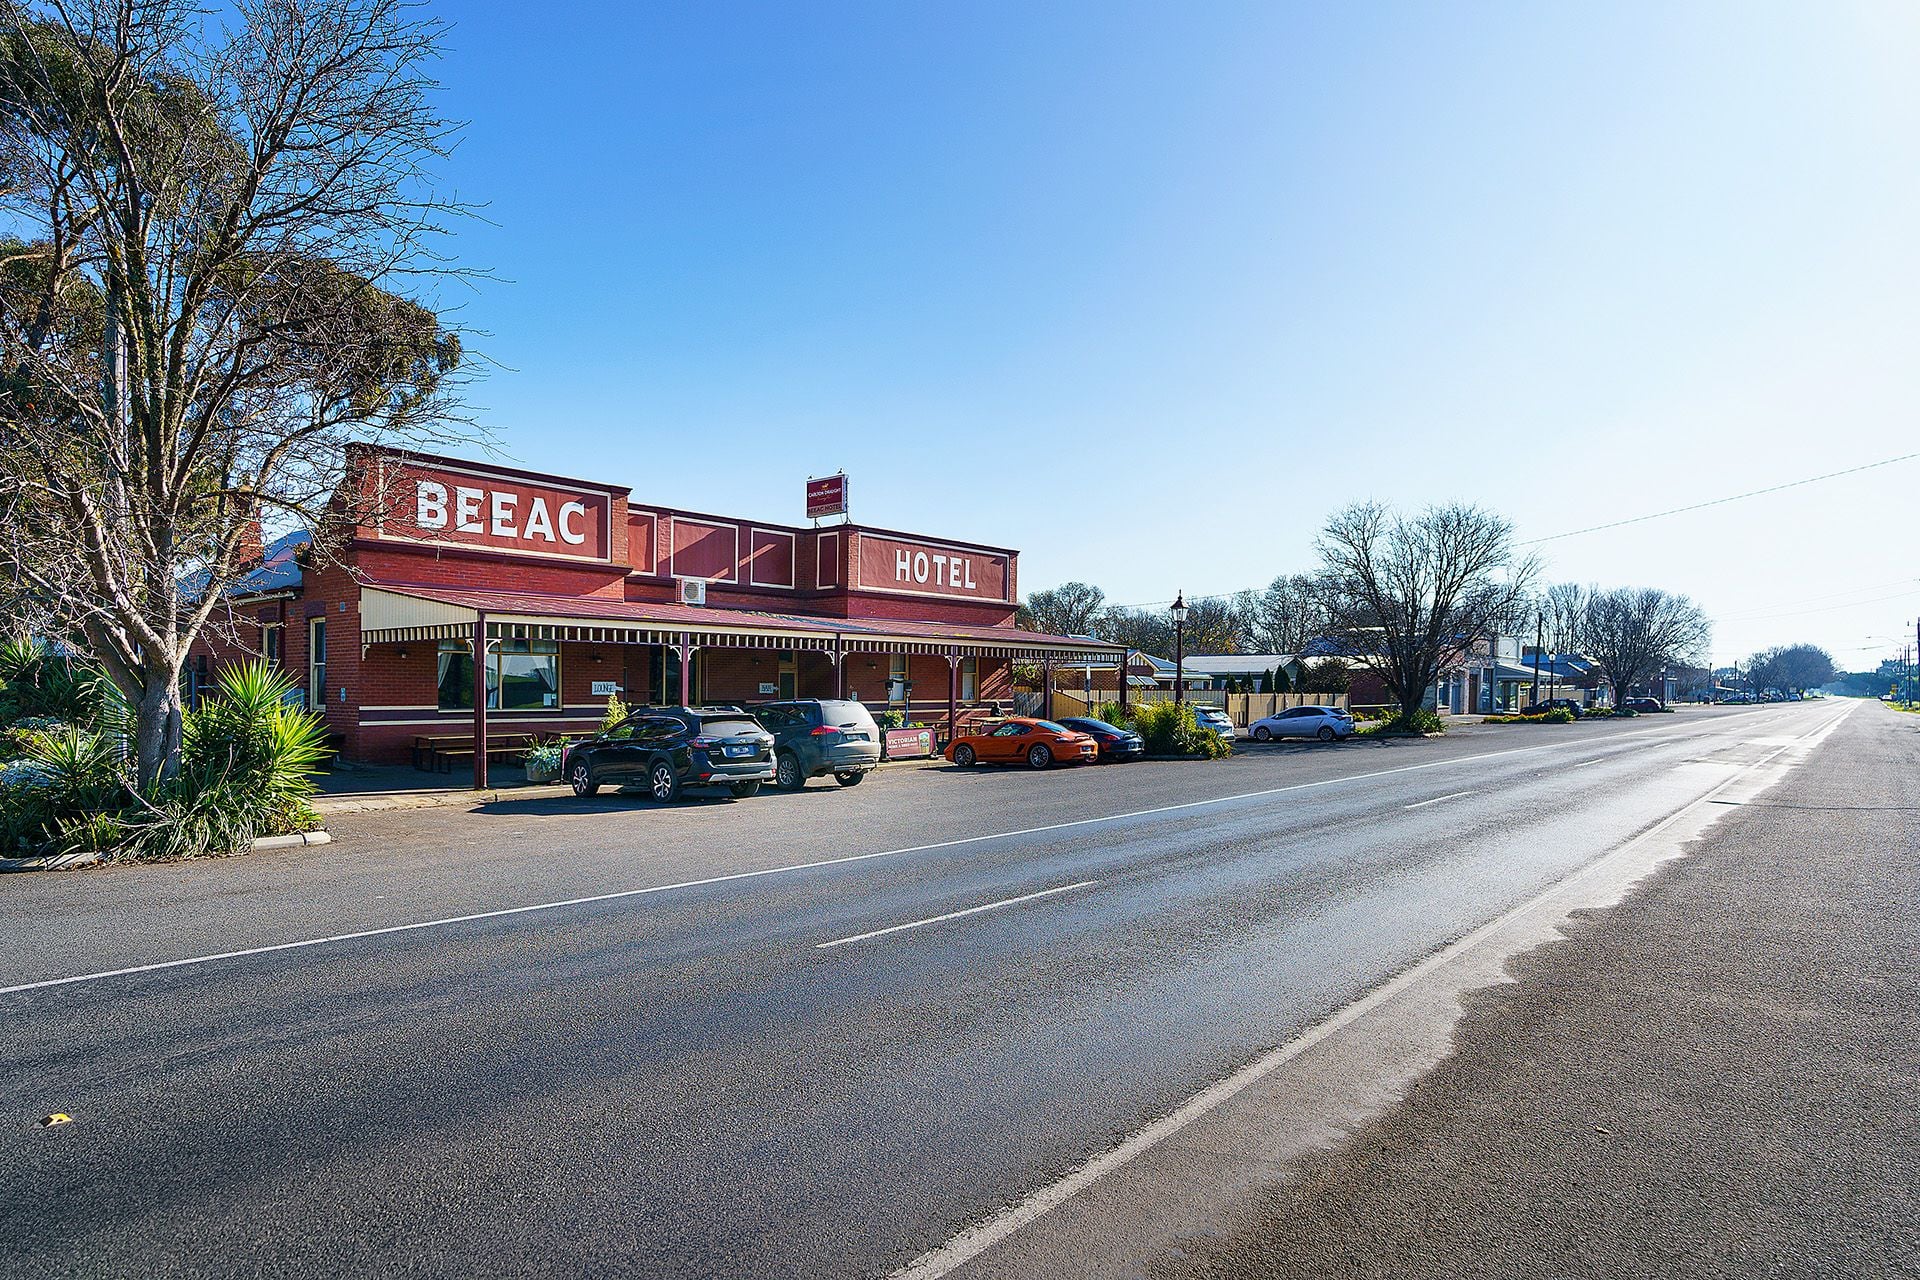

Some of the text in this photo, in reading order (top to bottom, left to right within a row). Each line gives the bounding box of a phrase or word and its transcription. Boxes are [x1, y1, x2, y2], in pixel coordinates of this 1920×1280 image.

[416, 480, 585, 545] BEEAC
[895, 548, 977, 590] HOTEL
[888, 736, 918, 745] VICTORIAN
